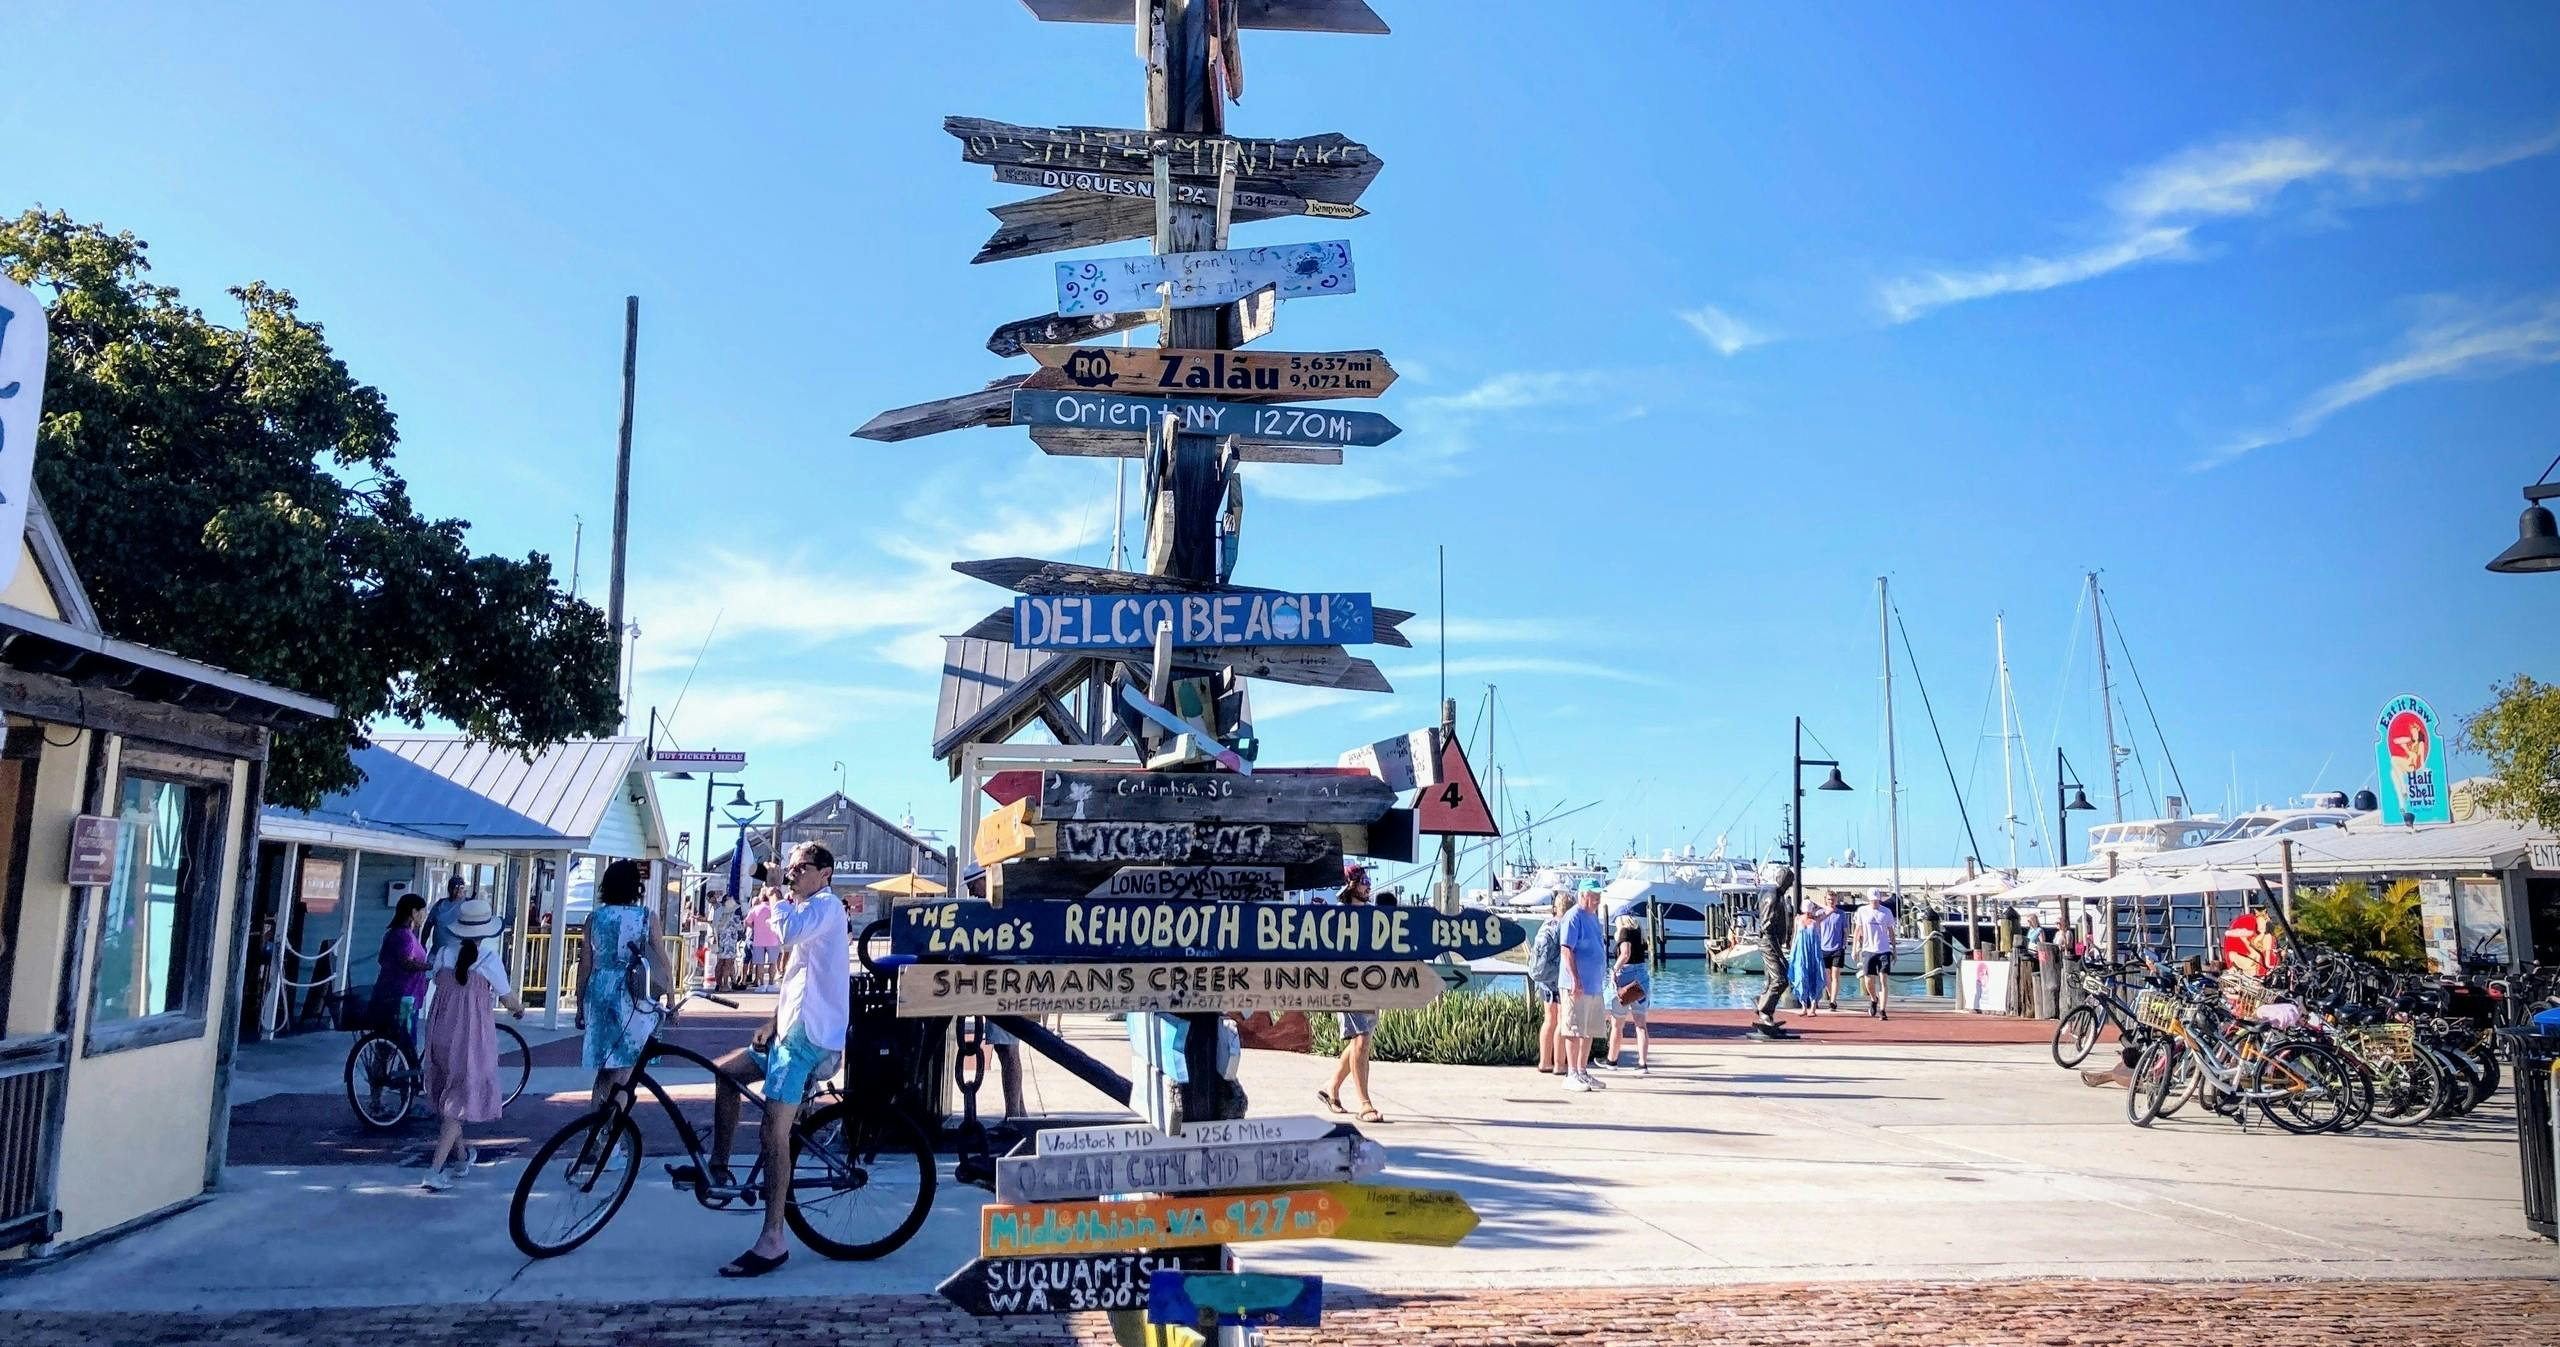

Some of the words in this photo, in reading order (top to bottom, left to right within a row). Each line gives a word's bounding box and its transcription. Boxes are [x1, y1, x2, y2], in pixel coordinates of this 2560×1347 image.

[1042, 170, 1156, 197] DUQUESN
[1177, 186, 1208, 204] PA
[1311, 203, 1355, 215] Kennywood
[1075, 357, 1107, 379] RO
[1289, 374, 1341, 390] 9,072
[1345, 374, 1372, 389] km
[1055, 396, 1169, 426] Orient
[1186, 404, 1226, 431] NY
[1020, 597, 1174, 645] DELCO
[1181, 594, 1331, 643] BEACH
[2380, 704, 2397, 730] Eat
[2397, 699, 2406, 712] it
[2409, 698, 2433, 723] Raw
[2407, 770, 2432, 785] Half
[2408, 784, 2434, 798] Shell
[1440, 782, 1463, 809] 4
[834, 861, 868, 870] ASTER
[2533, 844, 2560, 867] ENT
[907, 903, 959, 929] THE
[1065, 903, 1241, 950] REHOBOTH
[1257, 907, 1360, 952] BEACH
[1431, 914, 1502, 947] 1334.8
[928, 917, 1035, 952] LAMB'S
[932, 968, 1136, 997] SHERMANS
[1148, 966, 1250, 993] CREEK
[1139, 996, 1159, 1010] PA
[1306, 993, 1353, 1008] MILES
[1044, 1131, 1116, 1151] Woodstock
[1124, 1130, 1154, 1147] MD
[1196, 1124, 1233, 1144] 1256
[1200, 1150, 1239, 1186] MD
[1166, 1208, 1209, 1236] VA
[1226, 1197, 1292, 1237] 927
[1069, 1286, 1133, 1310] 3500
